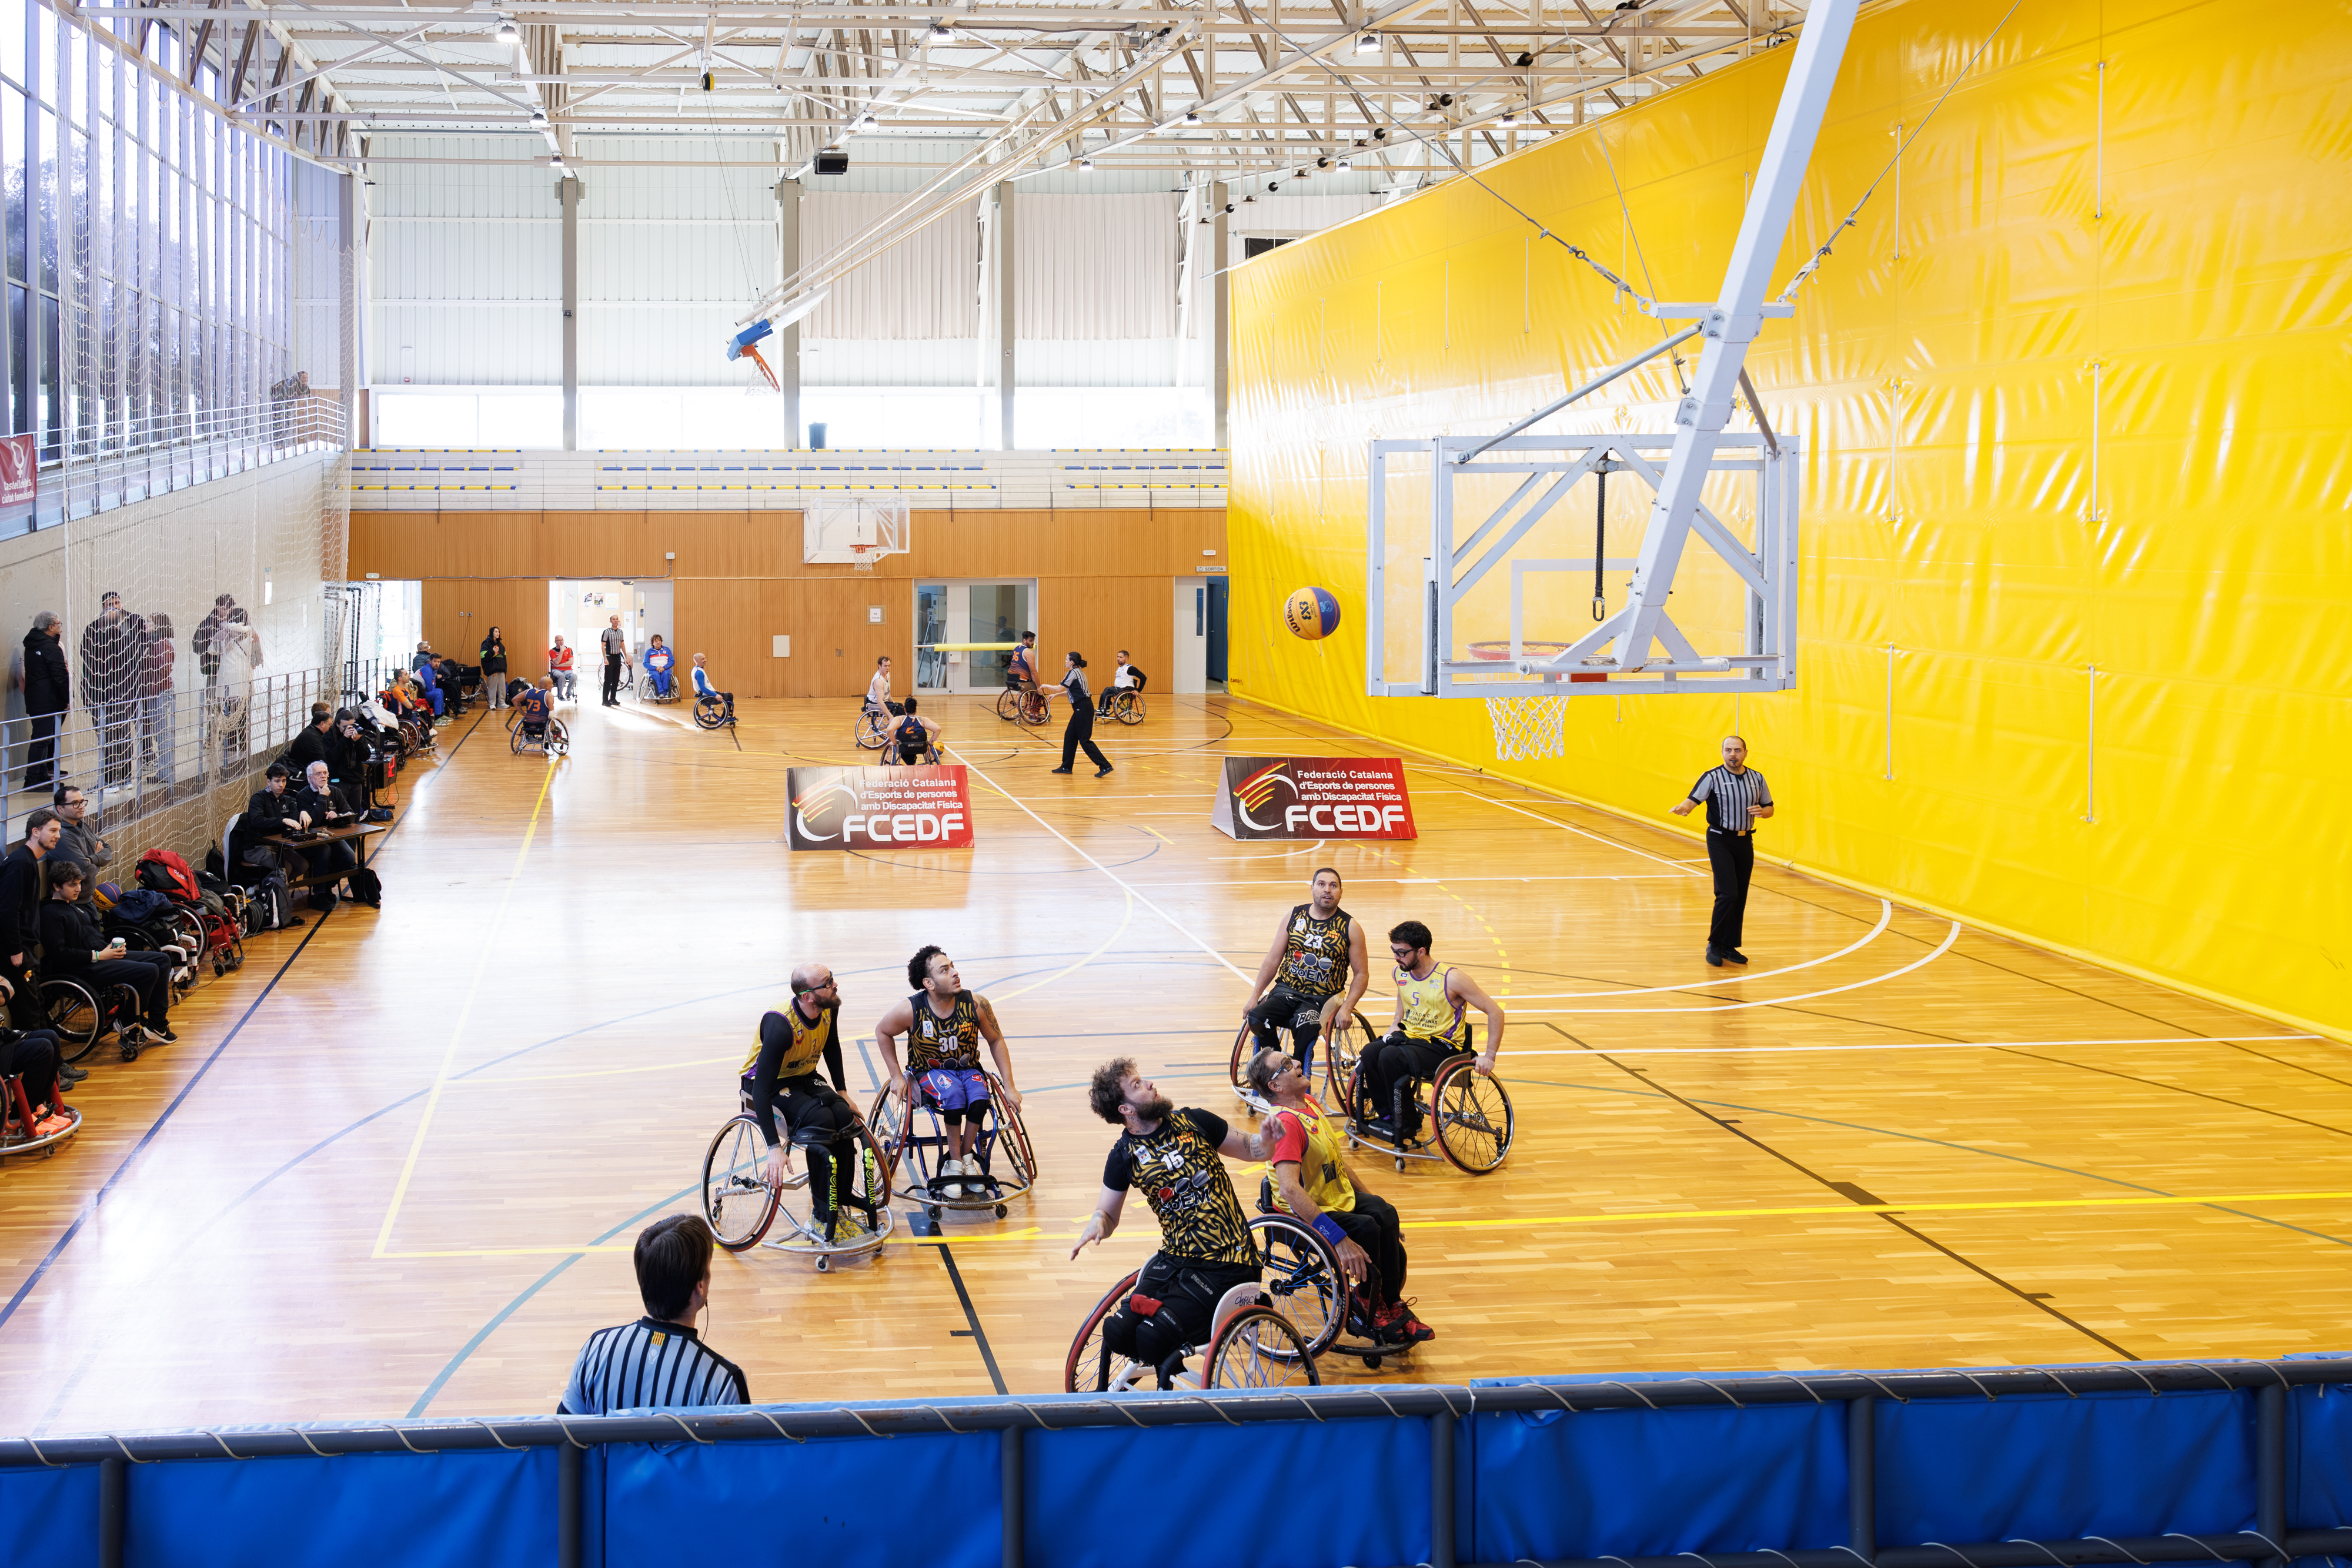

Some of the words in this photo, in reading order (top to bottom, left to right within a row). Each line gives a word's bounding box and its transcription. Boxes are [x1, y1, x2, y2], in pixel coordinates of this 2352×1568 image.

[2, 494, 14, 504] ciutat
[14, 490, 35, 502] feminista
[1287, 597, 1301, 633] Wilson
[527, 699, 540, 711] 73
[1297, 770, 1347, 779] Federació
[1349, 770, 1393, 779] Catalana
[859, 779, 910, 788] Federació
[912, 778, 957, 787] Catalana
[1299, 781, 1341, 791] d'Esports
[1342, 781, 1354, 790] de
[1355, 783, 1395, 791] persones
[860, 791, 902, 800] d'Esports
[917, 791, 957, 800] persones
[1301, 793, 1321, 801] amb
[1322, 793, 1375, 802] Discapacitat
[1377, 793, 1402, 801] Física
[861, 802, 881, 811] amb
[882, 801, 936, 811] Discapacitat
[937, 801, 963, 809] Física
[1285, 805, 1405, 832] FCEDF
[843, 813, 964, 842] FCEDF
[1304, 933, 1323, 949] 23
[1290, 963, 1330, 984] SoEM
[1412, 992, 1419, 1006] 5
[938, 1035, 958, 1052] 30
[1161, 1149, 1185, 1171] 15
